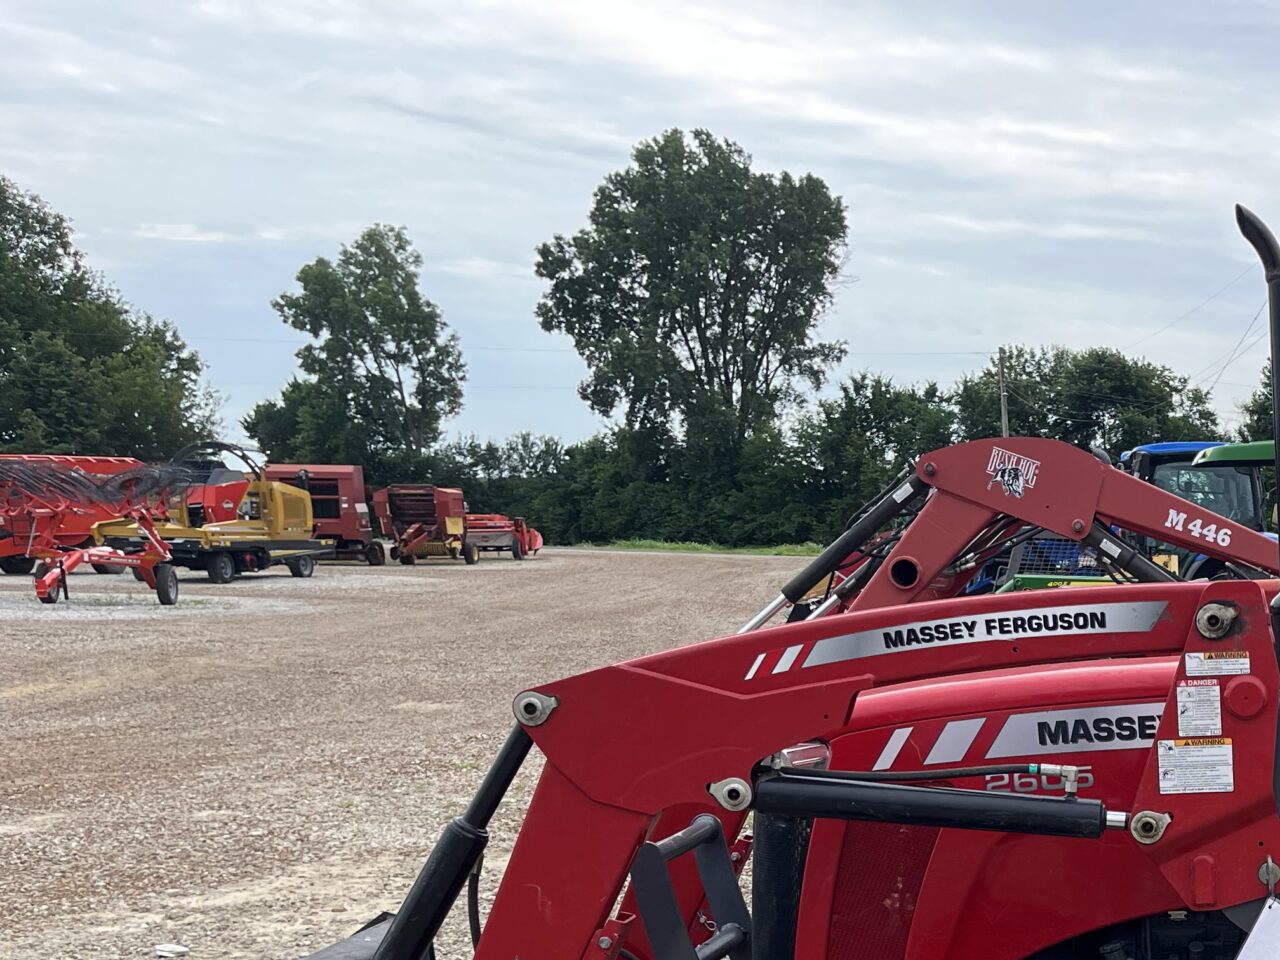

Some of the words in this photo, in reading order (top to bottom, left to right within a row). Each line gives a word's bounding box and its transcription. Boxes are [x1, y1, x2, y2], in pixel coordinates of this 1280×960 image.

[986, 447, 1018, 472] BUSH
[1017, 458, 1041, 487] HOG
[1164, 508, 1188, 532] M
[1187, 518, 1233, 548] 446
[882, 619, 978, 649] MASSEY
[984, 610, 1107, 636] FERGUSON
[1215, 651, 1248, 659] WARNING
[1037, 715, 1162, 745] MASSE
[1190, 738, 1226, 746] WARNING
